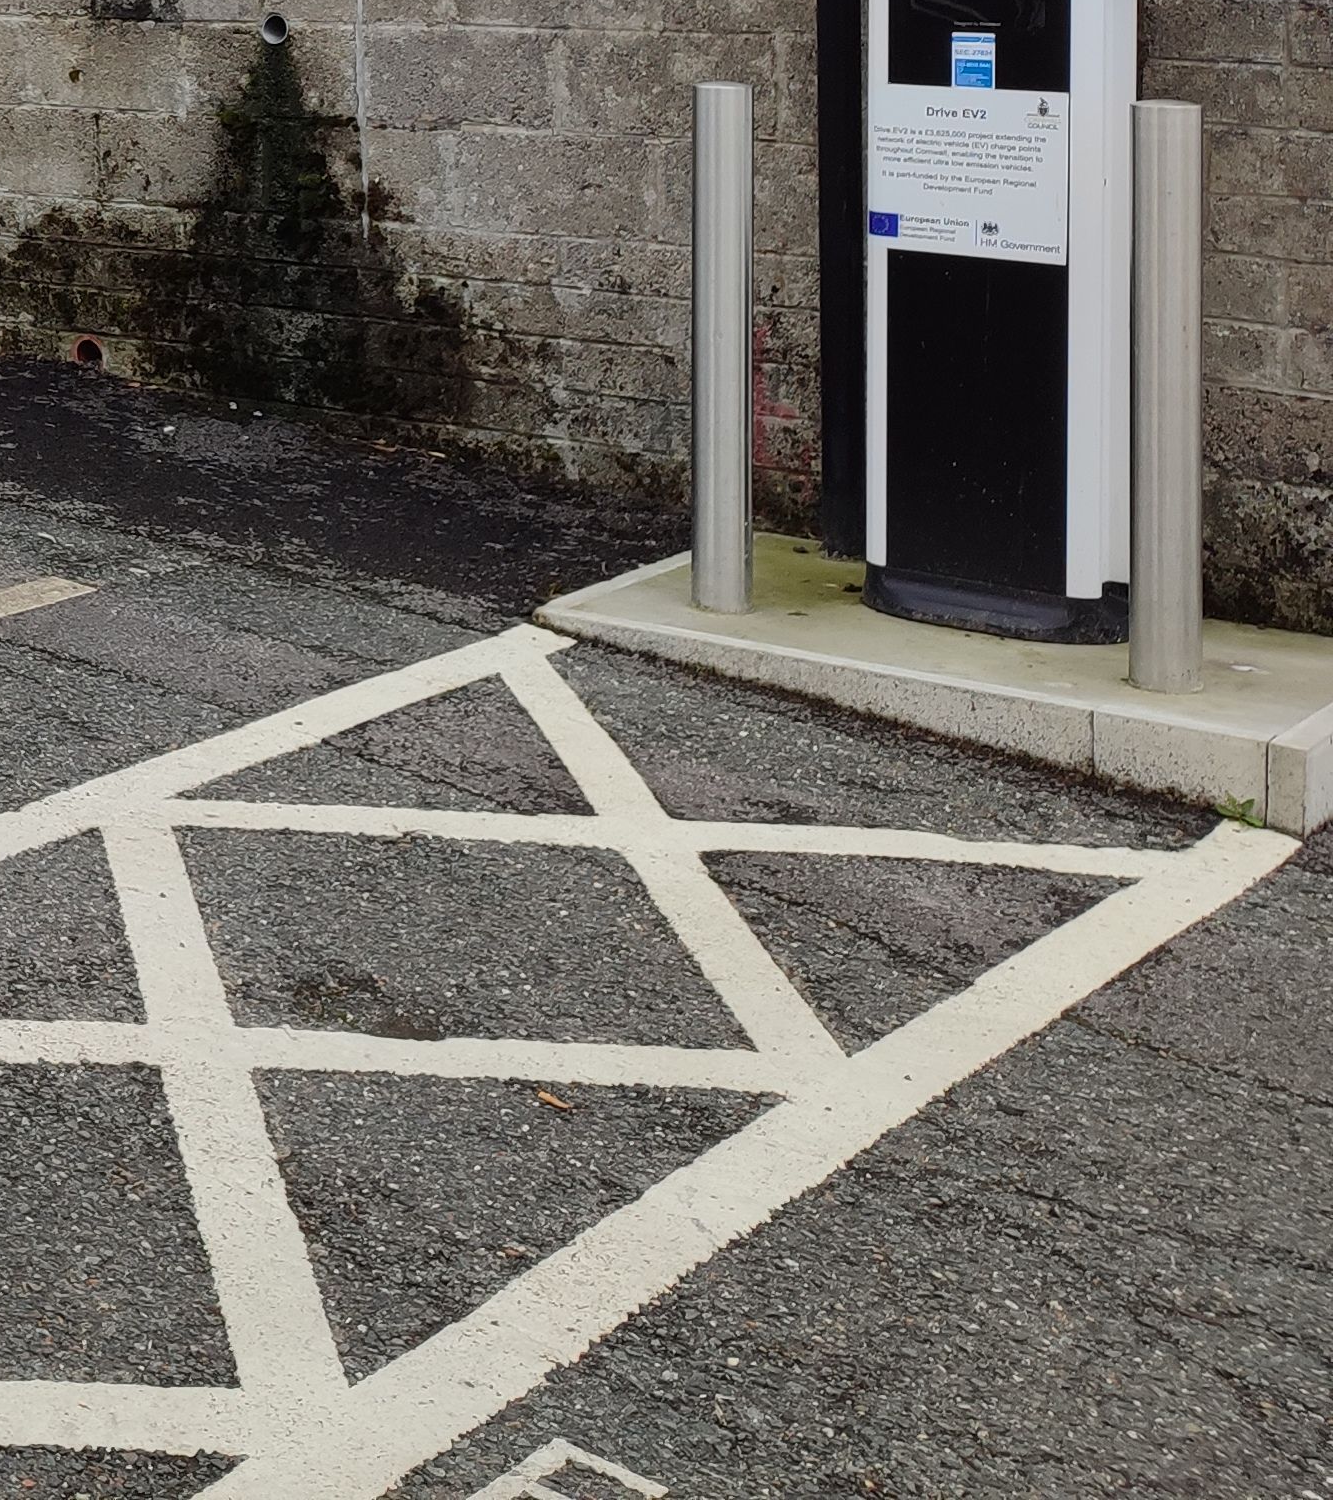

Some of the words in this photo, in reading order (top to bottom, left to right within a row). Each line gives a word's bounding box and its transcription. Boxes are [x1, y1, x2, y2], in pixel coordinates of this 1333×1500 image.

[927, 107, 957, 118] Drive
[963, 108, 987, 120] EV2
[995, 134, 1032, 143] extending
[943, 140, 969, 148] vehicle
[972, 142, 989, 150] (EV)
[991, 144, 1016, 152] charge
[999, 154, 1033, 162] transition
[897, 172, 937, 180] part-funded
[939, 174, 949, 182] by
[965, 176, 1001, 184] European
[1003, 179, 1037, 188] Regional
[923, 183, 971, 193] Development
[974, 187, 993, 195] Fund
[901, 214, 941, 225] European
[943, 217, 969, 227] Union
[981, 238, 997, 248] HM
[1001, 240, 1061, 254] Government
